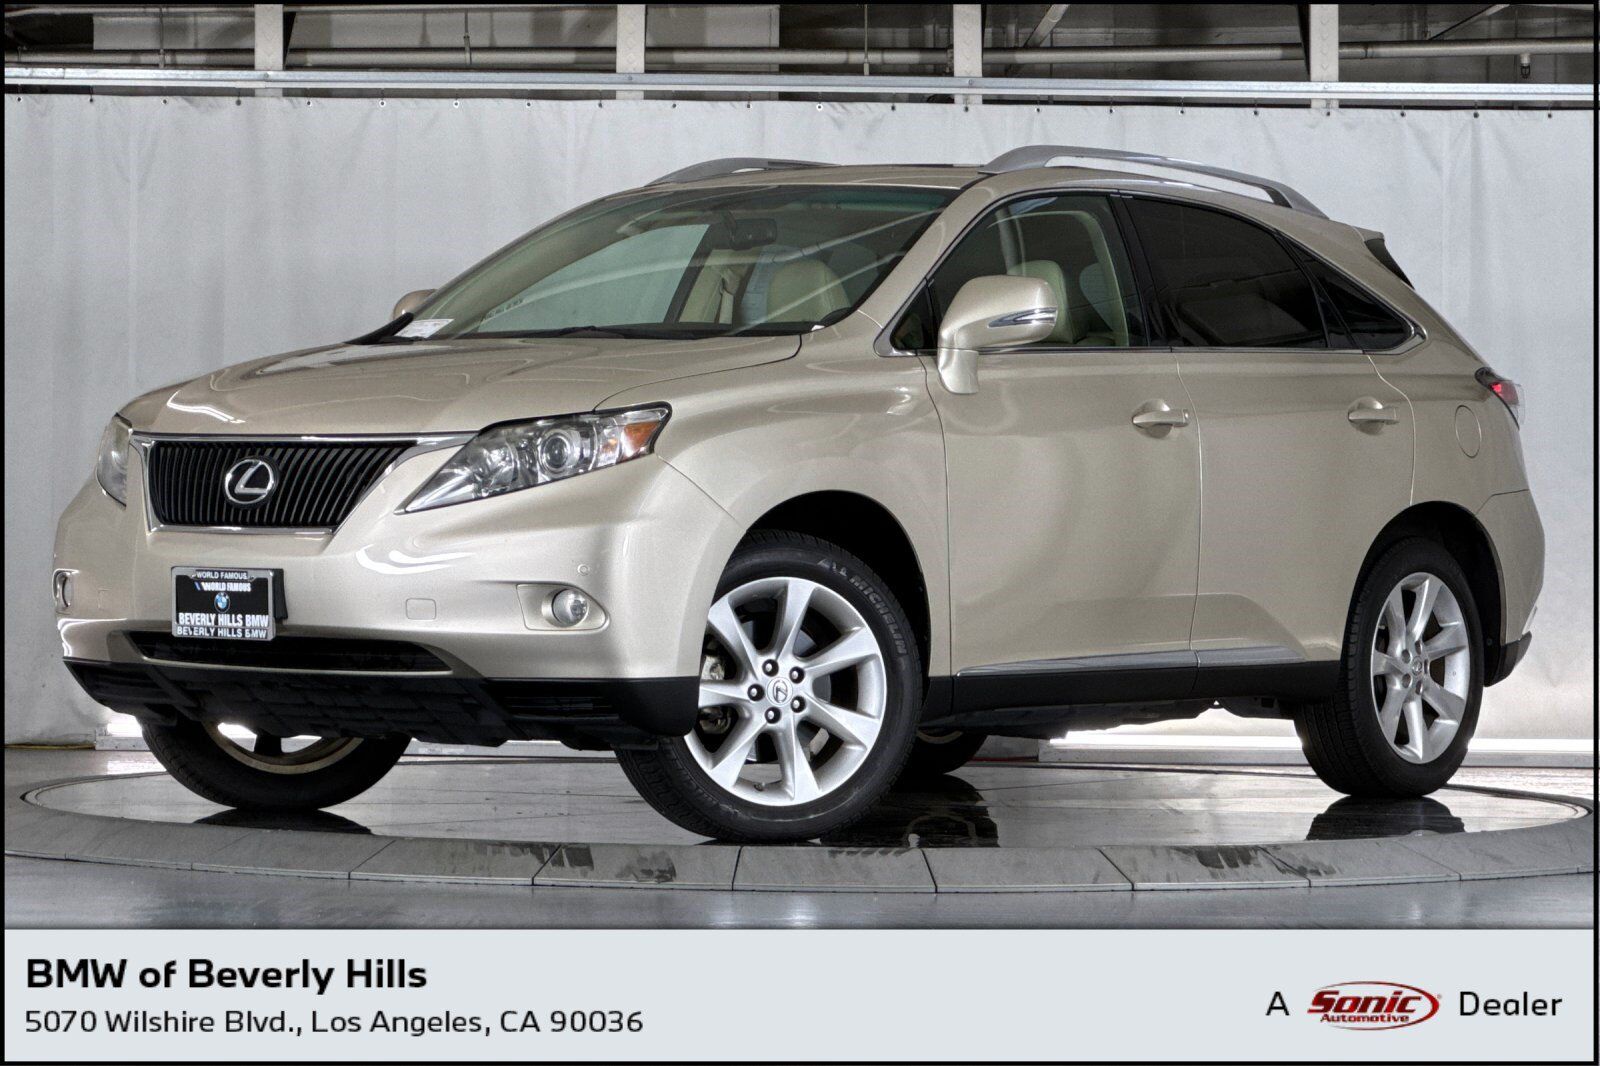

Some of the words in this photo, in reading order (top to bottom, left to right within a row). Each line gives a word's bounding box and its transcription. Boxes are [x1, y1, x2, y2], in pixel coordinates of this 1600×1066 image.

[196, 571, 220, 579] WORLD
[220, 572, 248, 580] FAMOUS
[202, 582, 226, 591] WORLD
[226, 582, 252, 592] FAMOUS
[178, 612, 216, 626] BEVERLY
[217, 613, 243, 627] HILLS
[245, 614, 269, 628] BMW
[849, 575, 907, 654] MICHELIN
[176, 626, 216, 636] BEVERLY
[217, 627, 243, 638] HILLS
